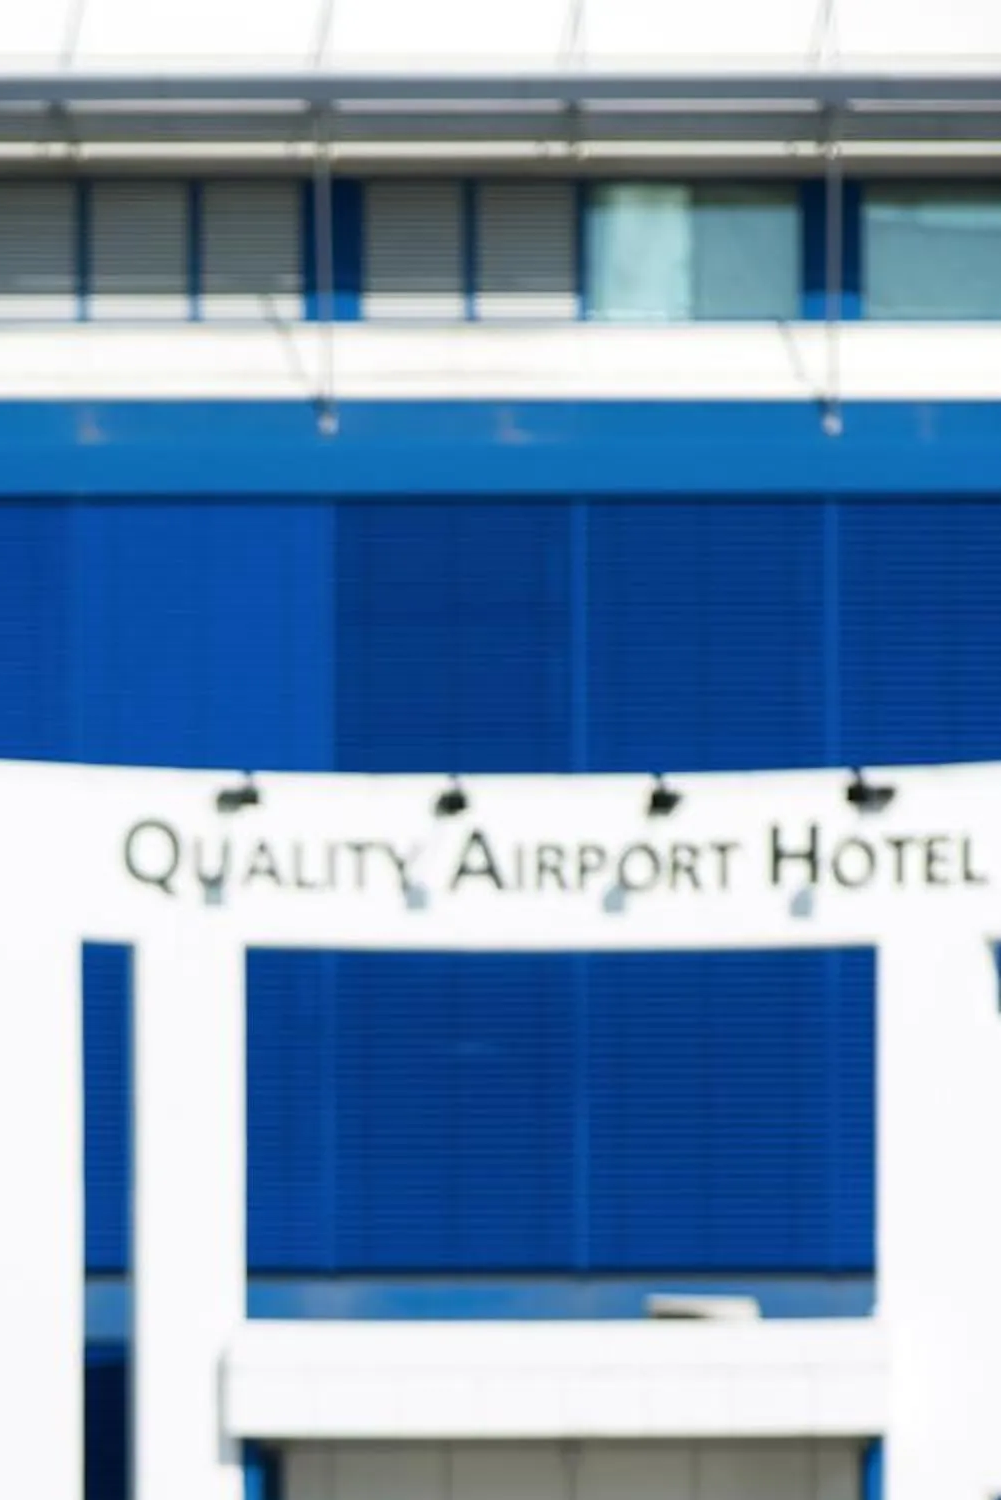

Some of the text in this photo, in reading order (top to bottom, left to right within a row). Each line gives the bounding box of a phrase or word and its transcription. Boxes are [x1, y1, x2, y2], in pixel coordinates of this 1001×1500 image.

[123, 818, 988, 894] QUALITY AIRPORT HOTEL
